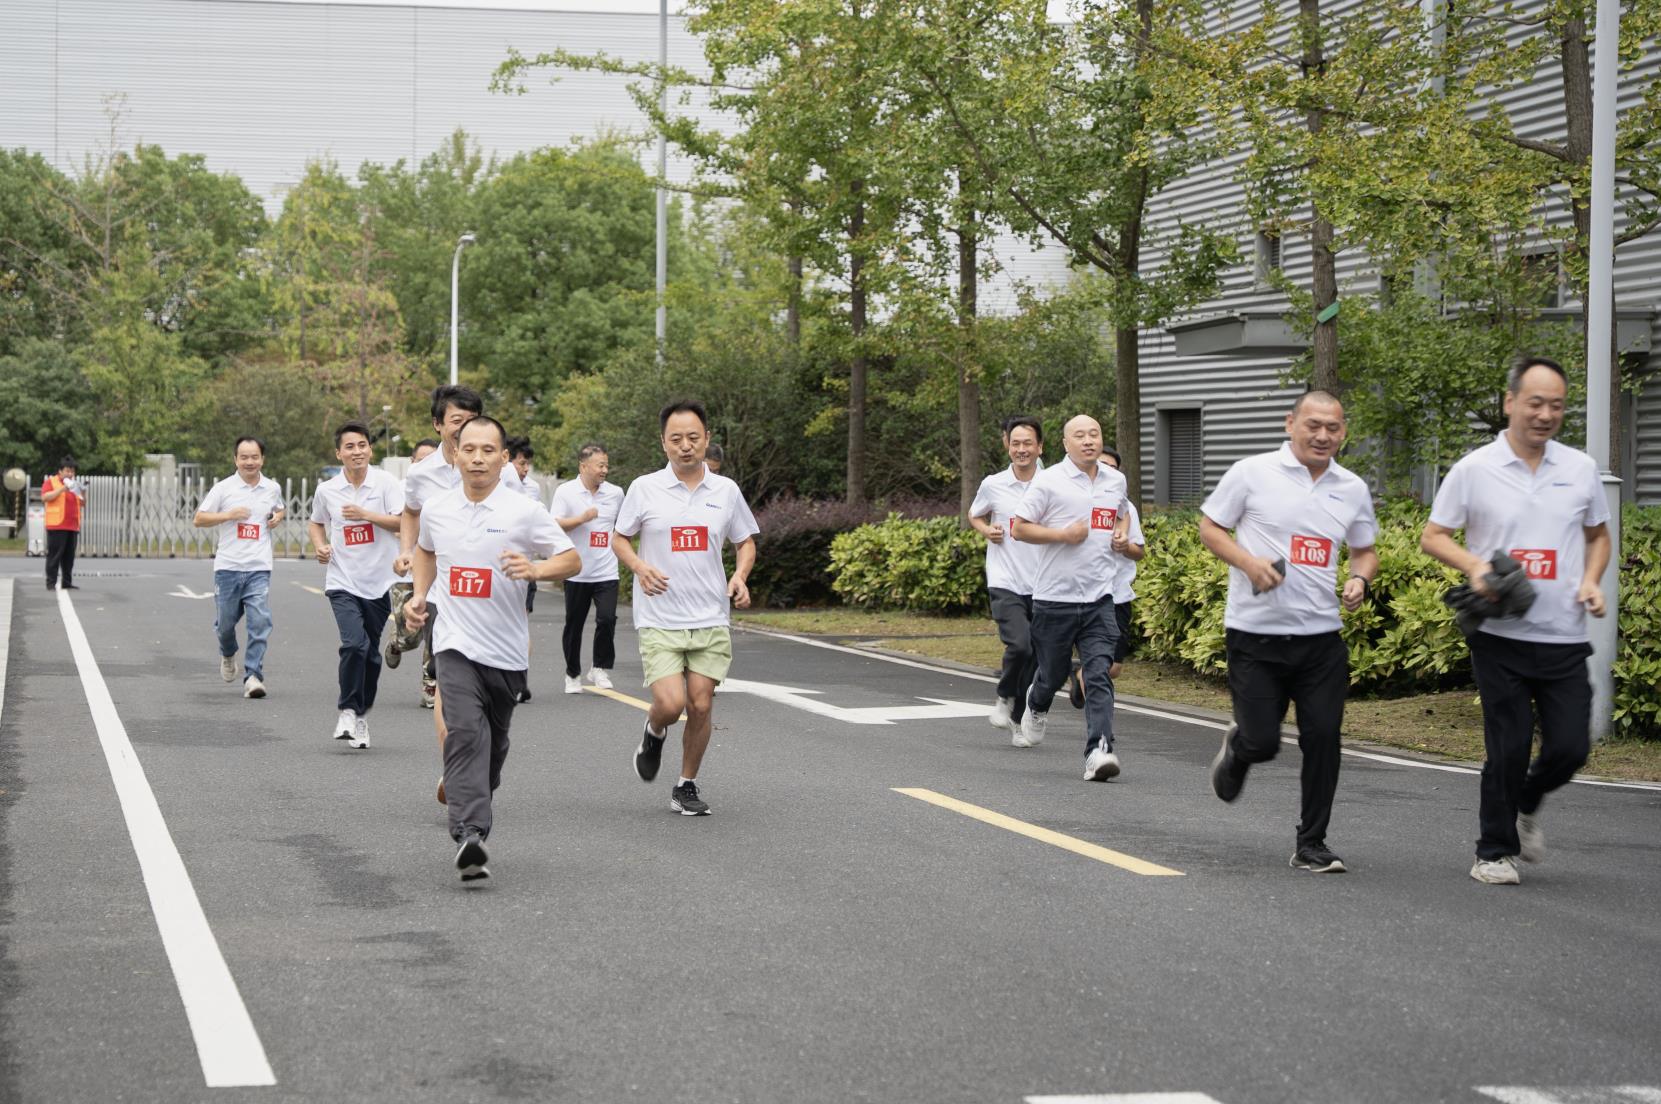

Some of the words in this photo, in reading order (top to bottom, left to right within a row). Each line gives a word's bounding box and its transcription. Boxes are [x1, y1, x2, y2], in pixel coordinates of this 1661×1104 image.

[1097, 516, 1113, 527] 106
[351, 532, 369, 542] 101
[679, 536, 700, 547] 111
[1299, 547, 1326, 563] 108
[457, 579, 484, 594] 117
